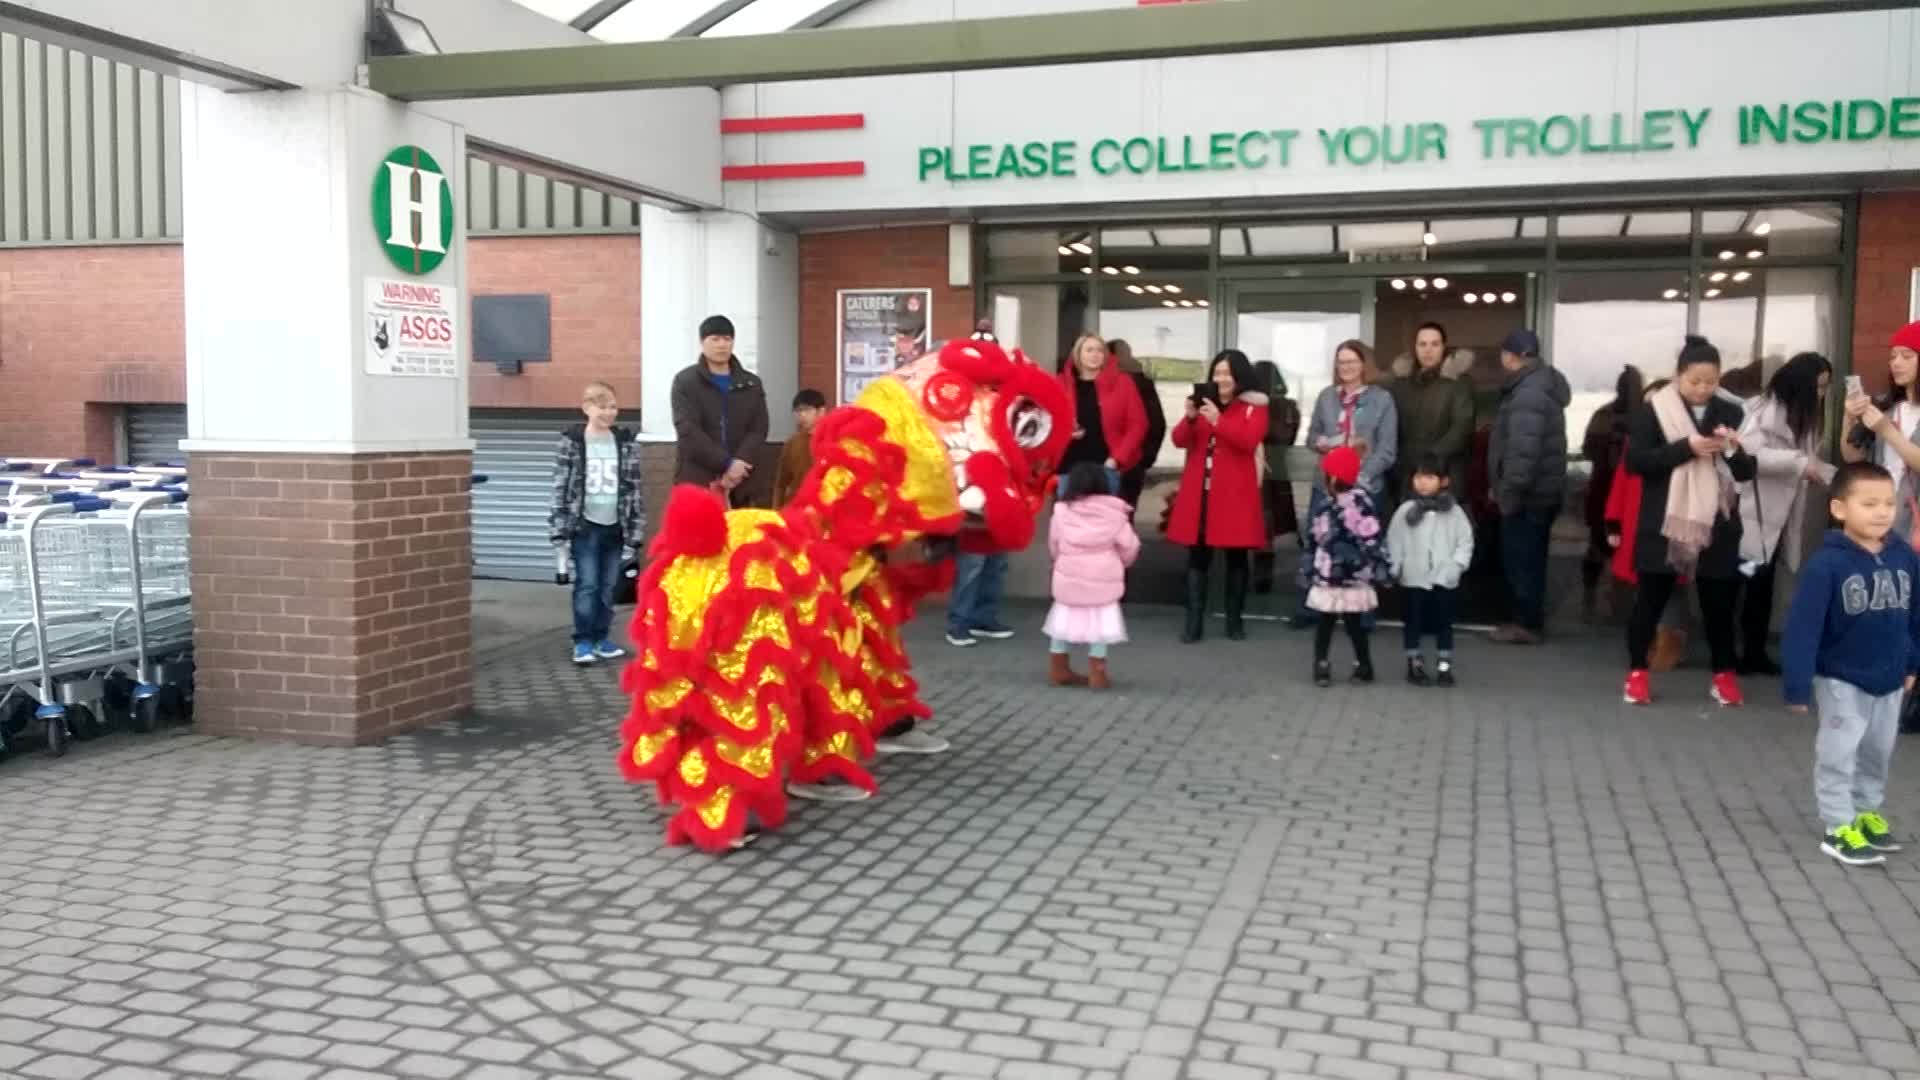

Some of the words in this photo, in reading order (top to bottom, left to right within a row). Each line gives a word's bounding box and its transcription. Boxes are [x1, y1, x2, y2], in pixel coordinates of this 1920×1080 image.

[918, 141, 1077, 182] PLEASE
[1091, 129, 1299, 175] COLLECT
[1317, 122, 1447, 166] YOUR
[1473, 108, 1712, 159] TROLLEY
[1739, 97, 1920, 145] INSIDE
[385, 161, 447, 254] H
[382, 282, 441, 304] WARNING
[400, 315, 453, 342] ASGS
